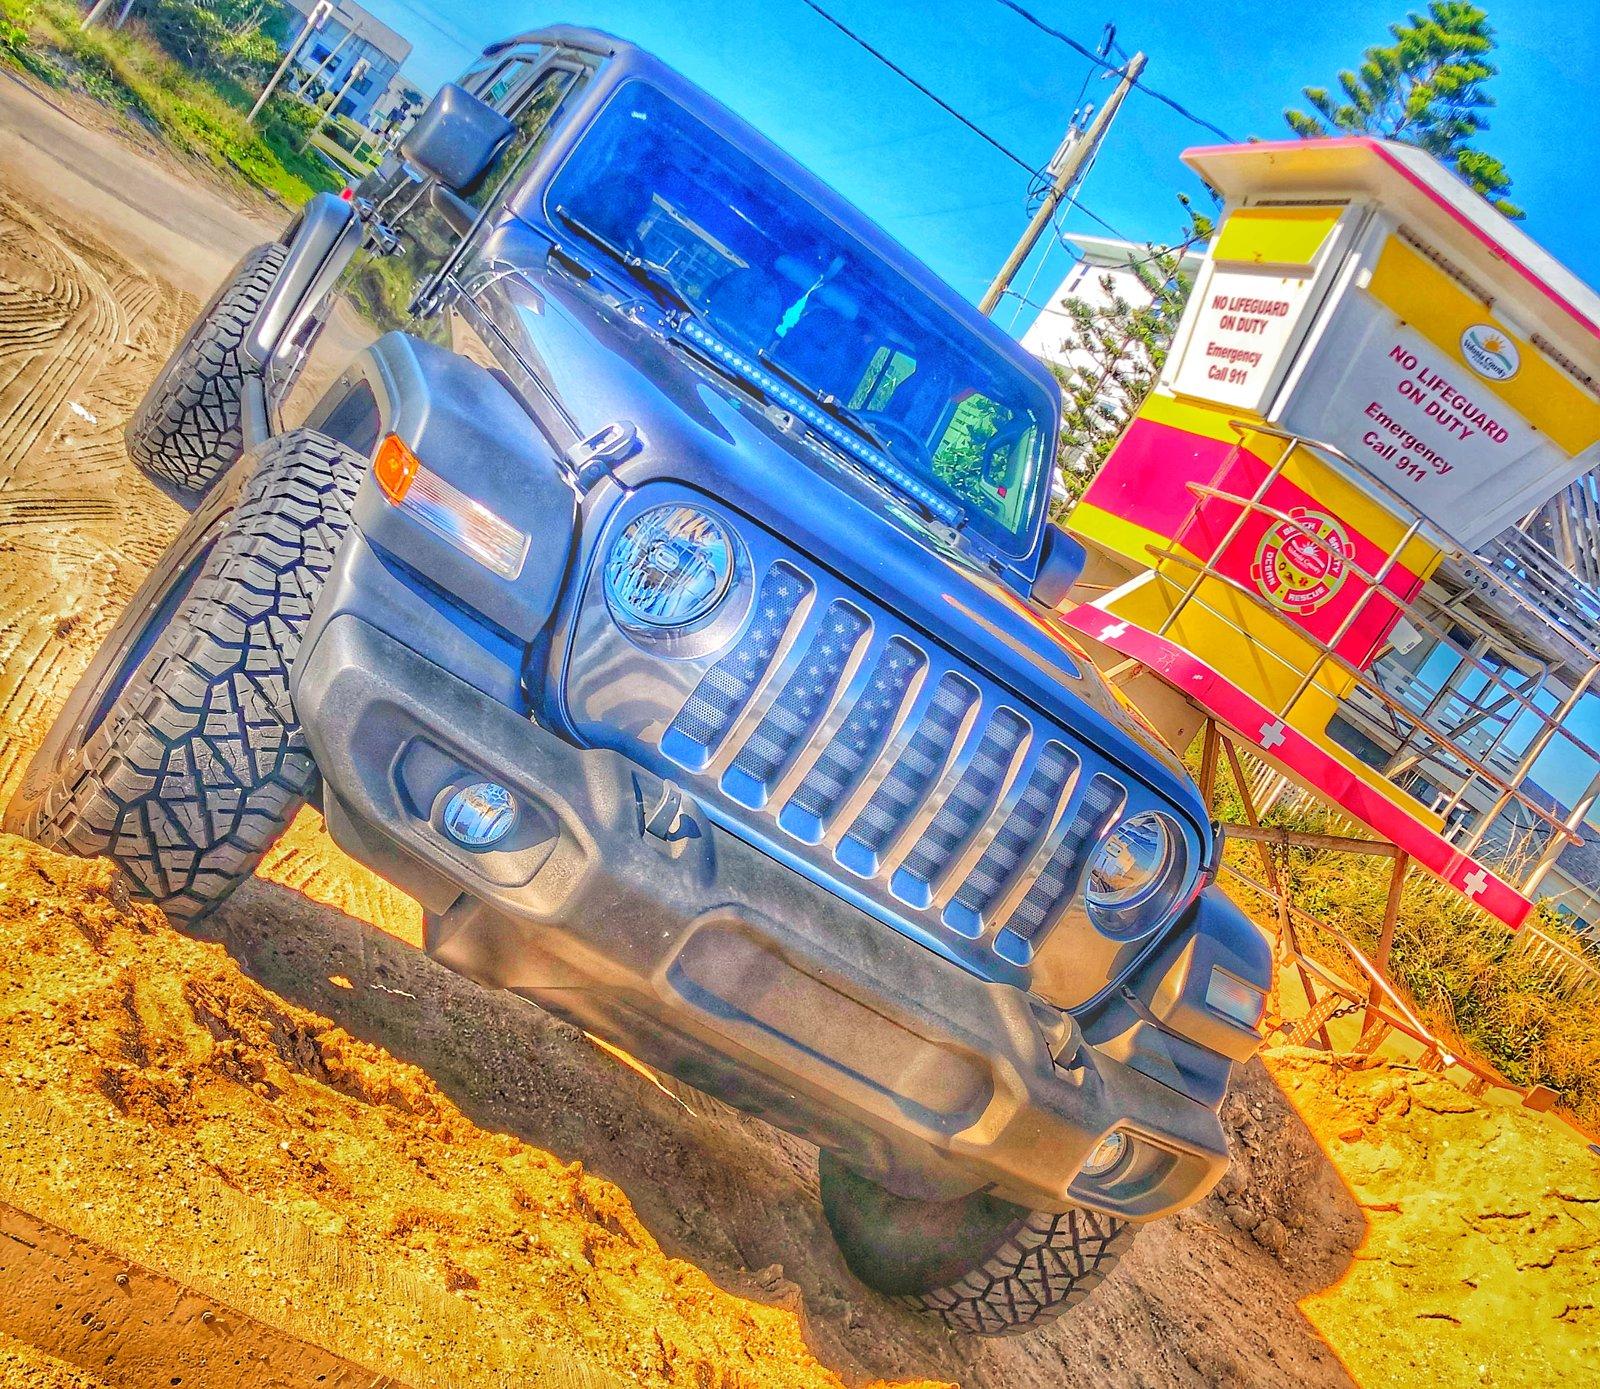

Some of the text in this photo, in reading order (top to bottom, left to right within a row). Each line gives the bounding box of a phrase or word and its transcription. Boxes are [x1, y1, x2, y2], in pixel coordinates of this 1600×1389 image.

[1212, 295, 1289, 317] NO LIFEGUARD
[1219, 315, 1269, 335] ON DUTY
[1206, 342, 1262, 367] Emergency
[1208, 365, 1248, 385] Call 911
[1388, 345, 1509, 444] NO LIFEGUARD
[1398, 379, 1475, 441] ON DUTY
[1364, 402, 1454, 476] Emergency
[1362, 431, 1428, 483] Call 911
[1282, 522, 1316, 536] BECH
[1264, 551, 1276, 586] OCEAN
[1288, 586, 1326, 601] RESCUE
[1464, 569, 1497, 597] 6598
